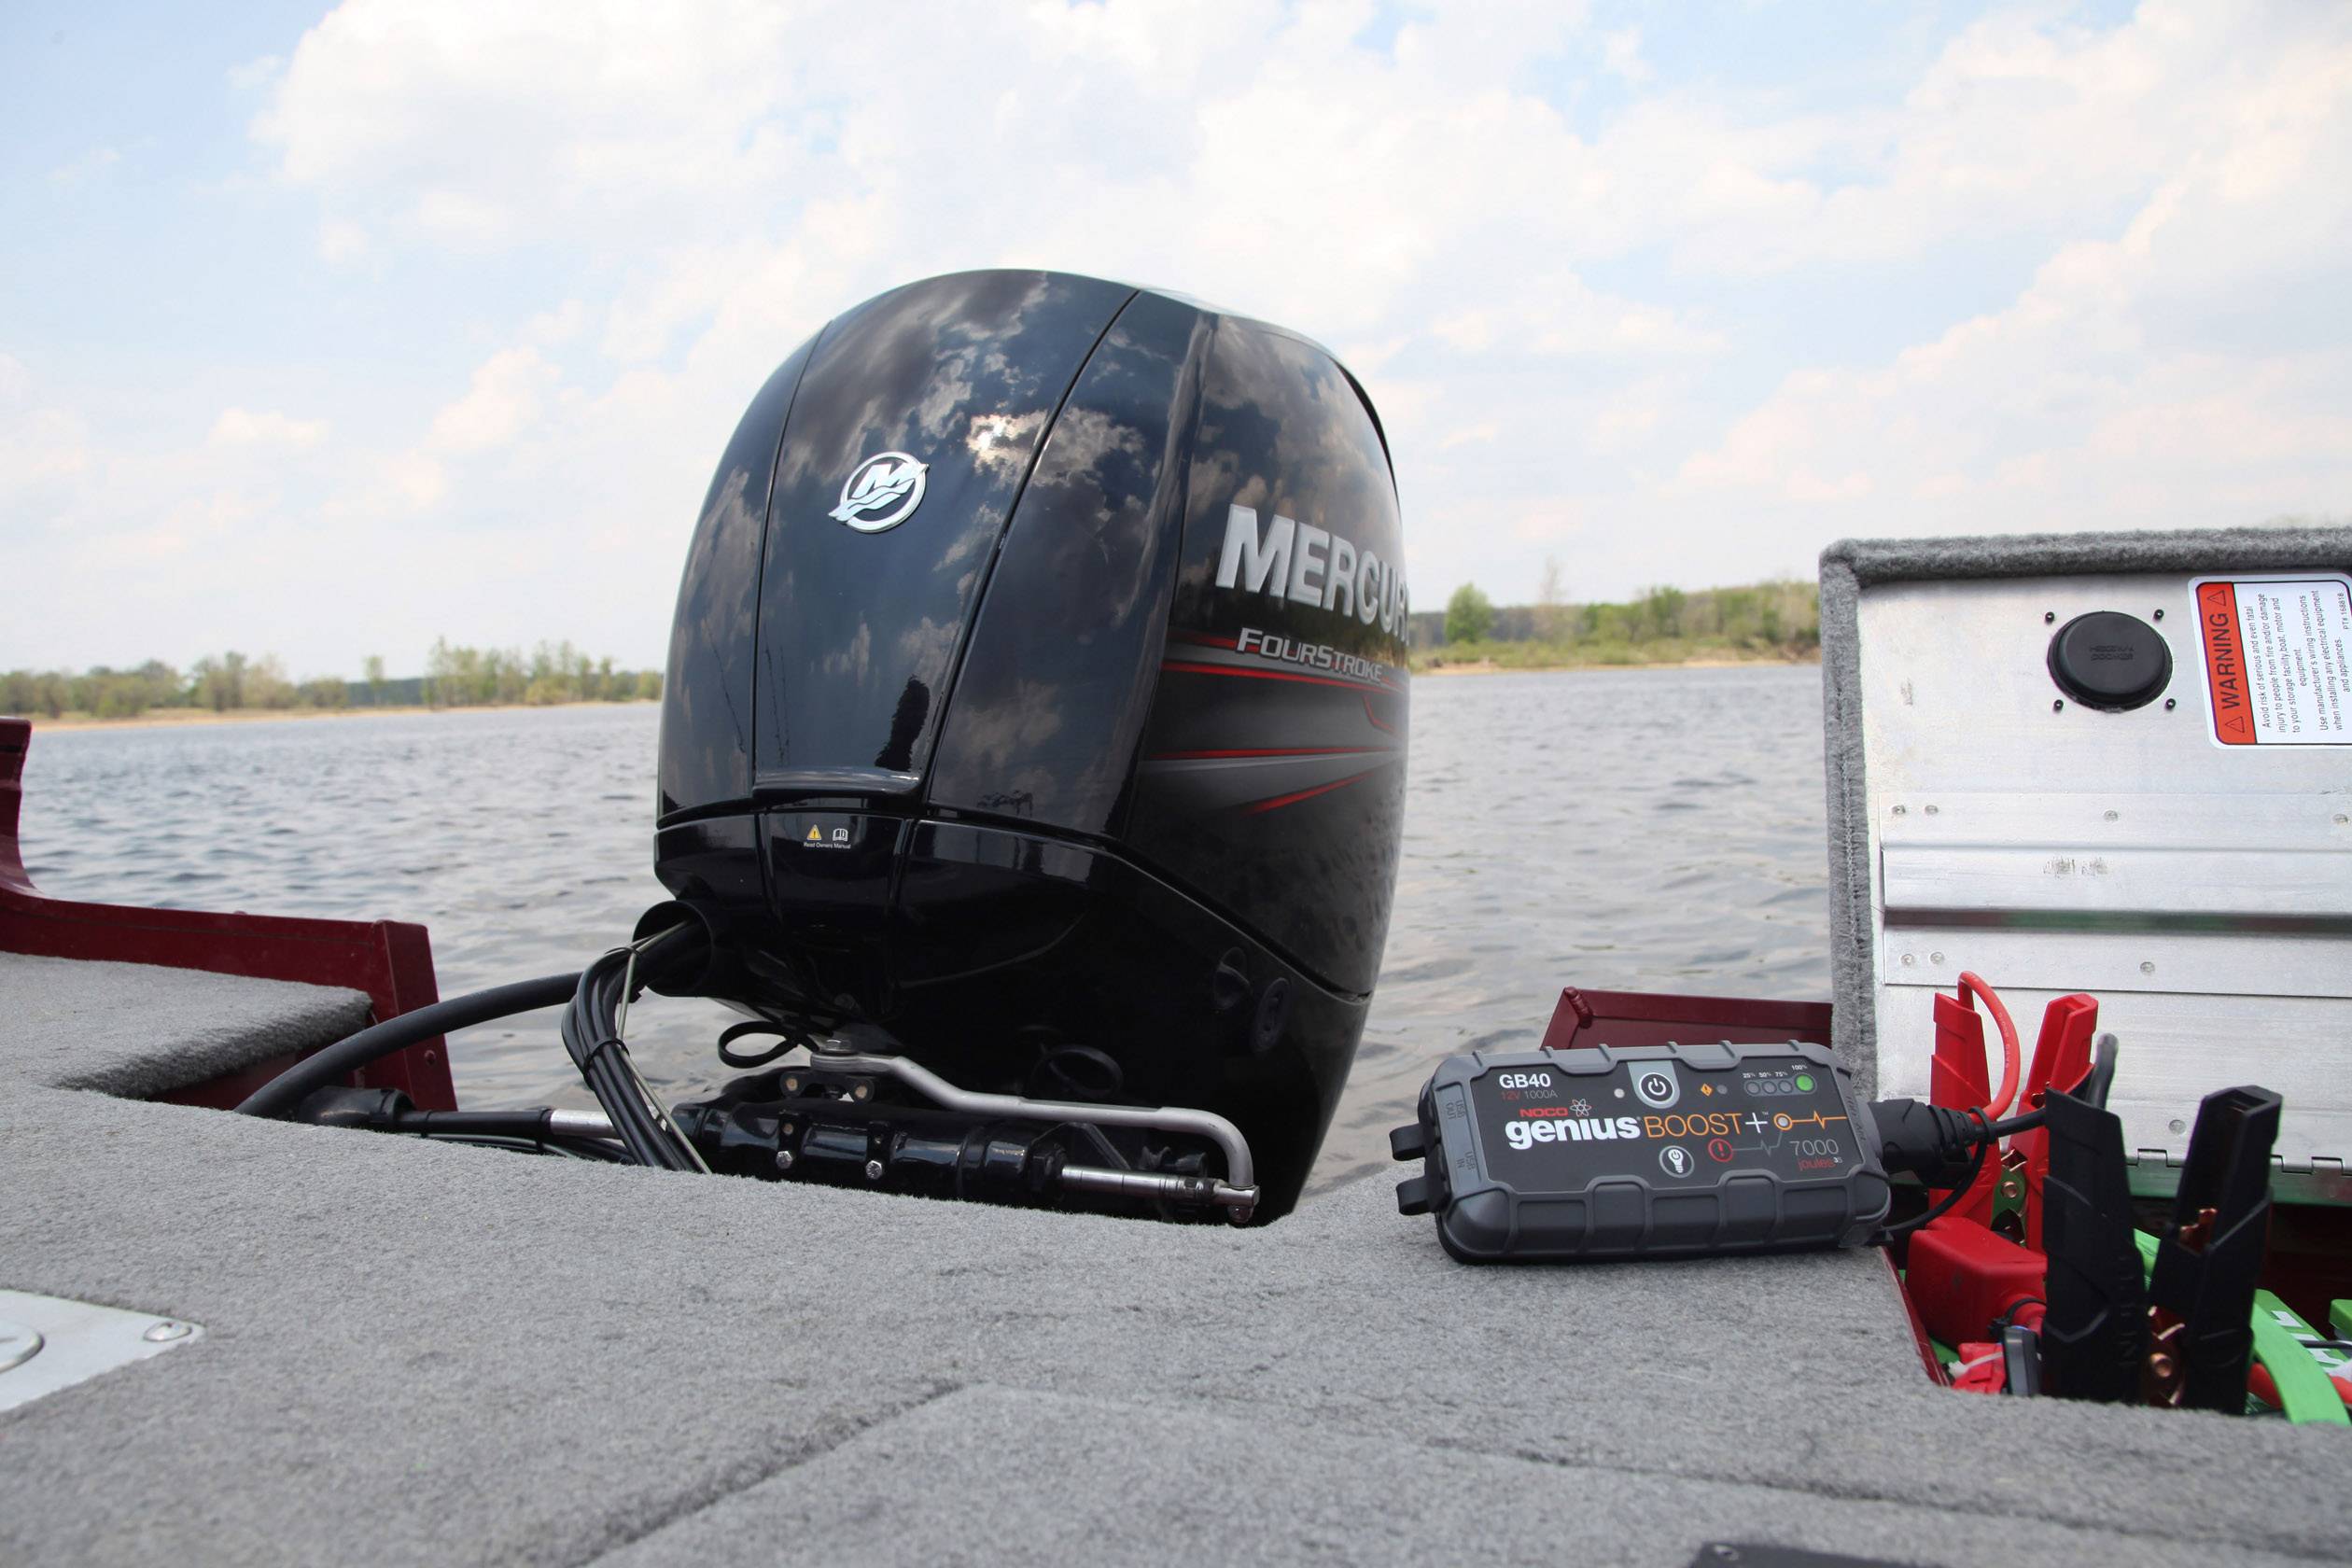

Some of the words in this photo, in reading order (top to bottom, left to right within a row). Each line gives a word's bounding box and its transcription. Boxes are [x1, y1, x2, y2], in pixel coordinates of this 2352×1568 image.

[1215, 503, 1409, 647] MERCUR
[2244, 606, 2254, 621] fatal
[2258, 594, 2268, 621] damage
[2270, 597, 2280, 611] and
[2311, 590, 2325, 626] equipment
[2275, 612, 2284, 633] motor
[2300, 595, 2312, 636] instructions
[2248, 623, 2258, 638] even
[2262, 623, 2272, 644] and/or
[2250, 640, 2260, 653] and
[2265, 646, 2275, 657] fire
[2306, 637, 2316, 659] wiring
[2317, 628, 2331, 660] electrical
[2209, 613, 2240, 709] WARNING
[2254, 655, 2264, 681] serious
[2268, 658, 2276, 676] from
[2324, 662, 2334, 675] any
[2256, 682, 2265, 691] of
[2270, 677, 2283, 701] people
[2285, 678, 2296, 705] storage
[2310, 660, 2326, 715] manufacturer's
[2327, 676, 2339, 709] installing
[2340, 679, 2351, 693] and
[2258, 692, 2267, 706] risk
[2275, 702, 2283, 710] to
[2260, 707, 2271, 728] Avoid
[2276, 711, 2288, 733] injury
[2290, 707, 2301, 723] your
[2319, 716, 2329, 731] Use
[2333, 710, 2343, 731] when
[2292, 724, 2301, 733] to
[1499, 1073, 1551, 1088] GB40
[1524, 1089, 1559, 1099] 1000A
[1455, 1099, 1465, 1119] USB
[1519, 1107, 1569, 1118] NOCO
[1505, 1116, 1641, 1150] genius
[1789, 1139, 1839, 1156] 7000
